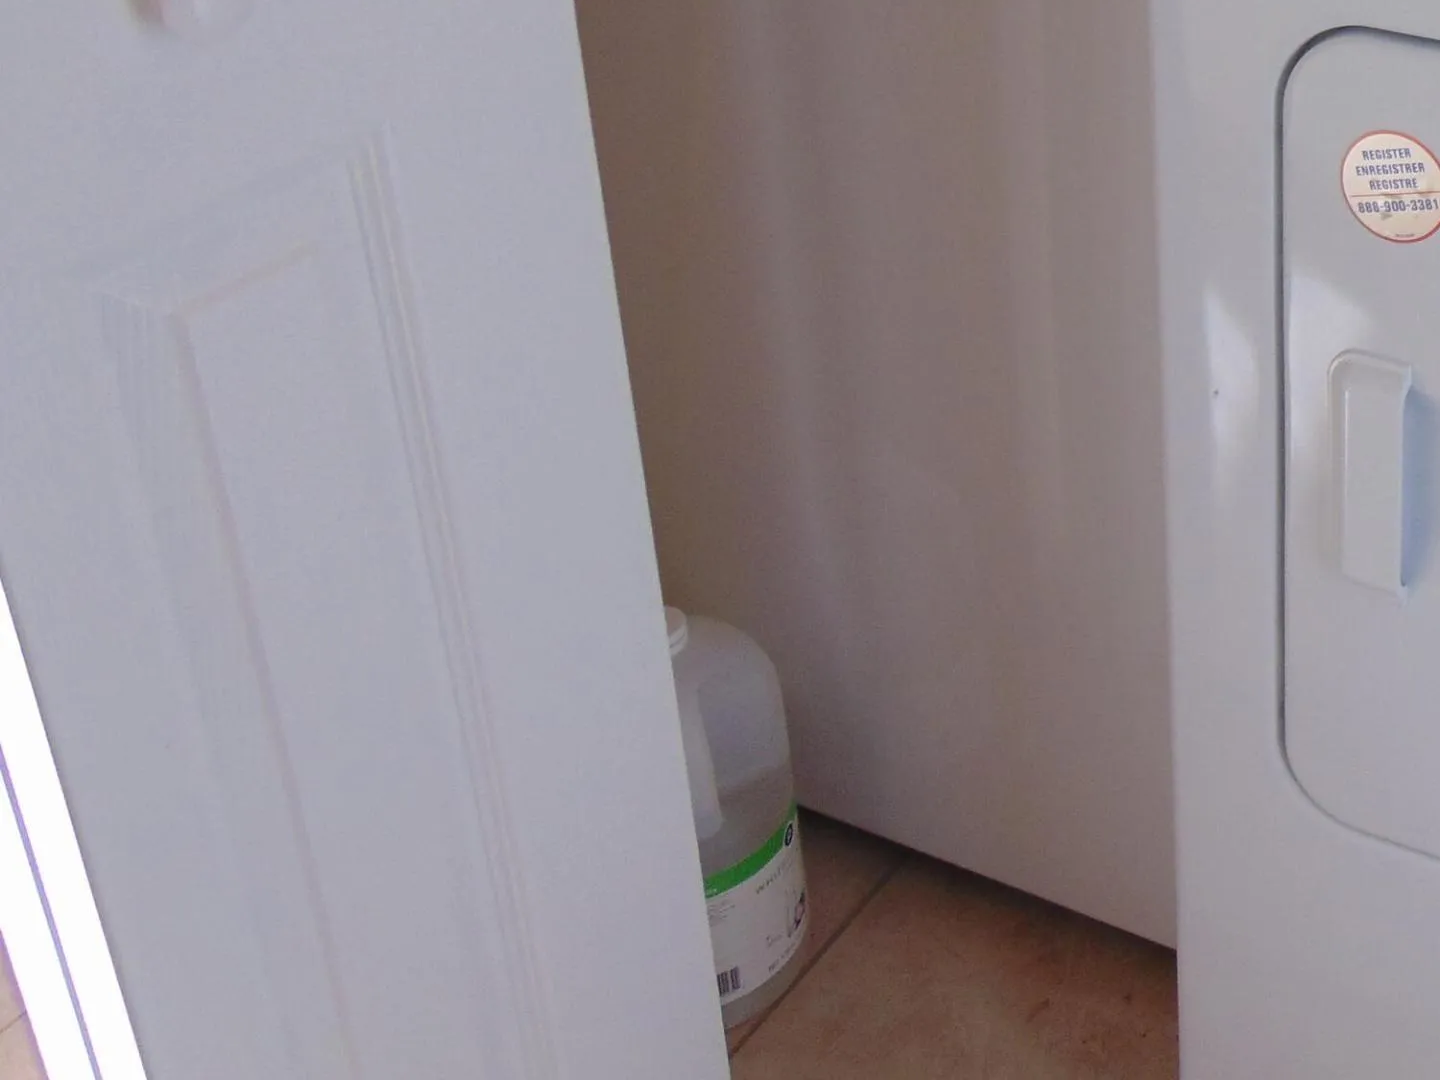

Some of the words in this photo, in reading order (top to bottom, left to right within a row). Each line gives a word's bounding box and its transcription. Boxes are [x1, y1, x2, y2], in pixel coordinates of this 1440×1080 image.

[1362, 148, 1412, 161] REGISTER
[1355, 162, 1426, 176] ENREGISTRER
[1368, 178, 1419, 191] REGISTRE
